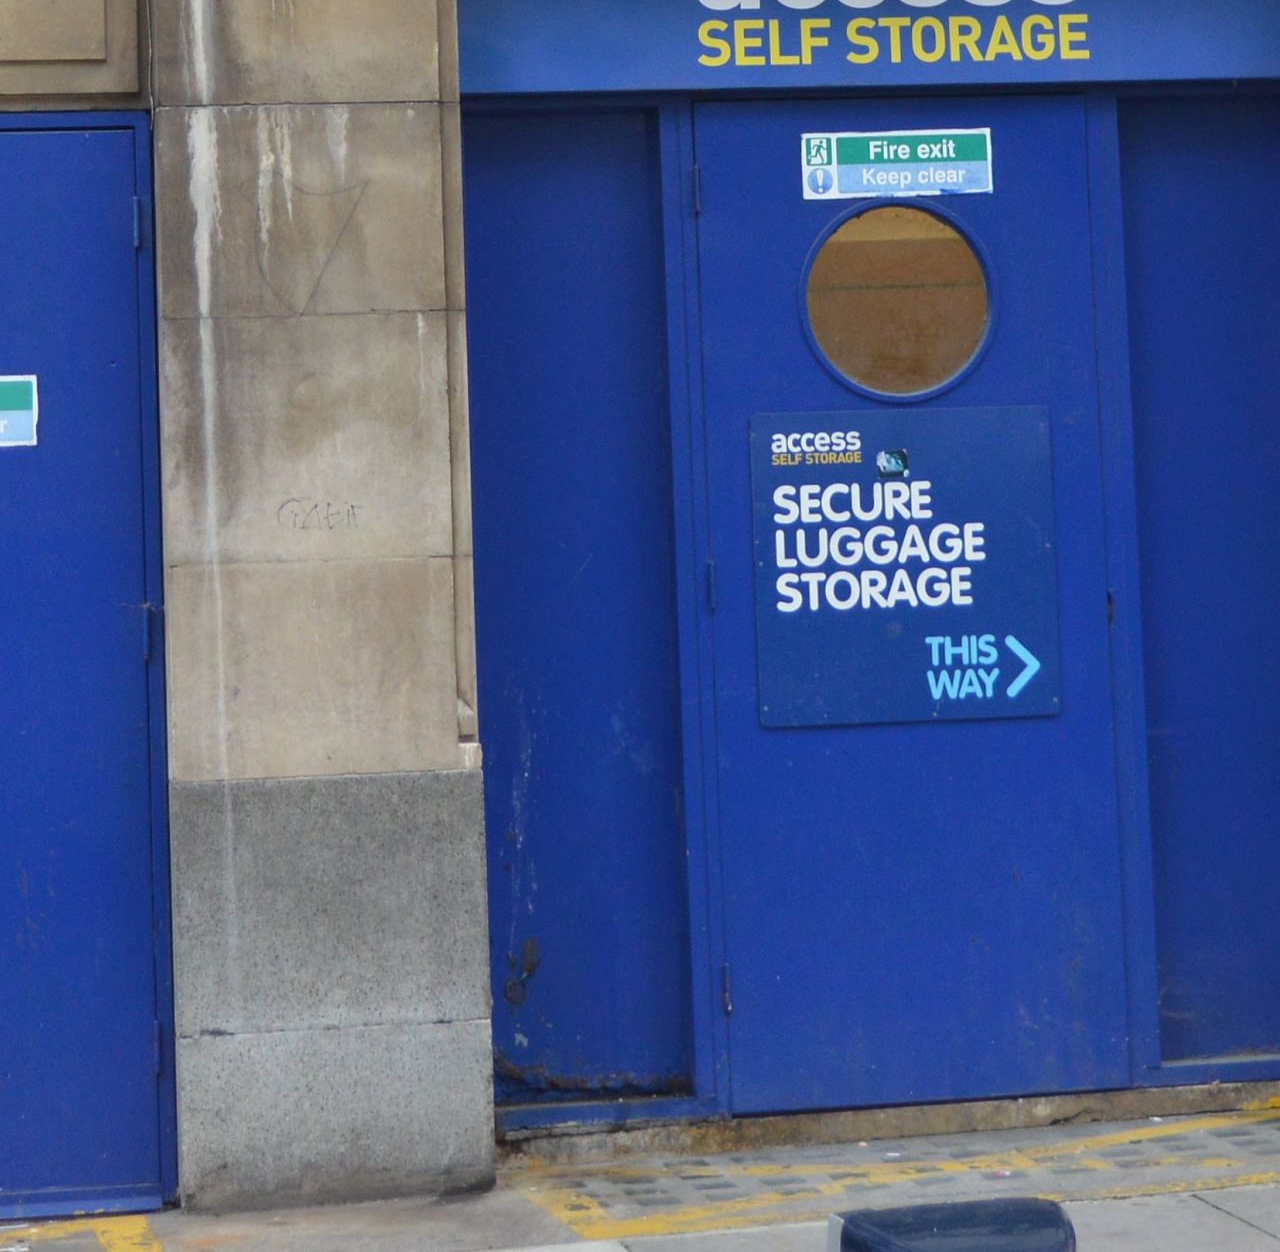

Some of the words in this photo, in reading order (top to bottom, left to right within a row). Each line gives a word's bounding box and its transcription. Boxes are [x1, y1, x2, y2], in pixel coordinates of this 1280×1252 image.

[697, 18, 830, 67] SELF
[846, 13, 1090, 64] STORAGE
[869, 140, 910, 160] Fire
[917, 139, 956, 159] exit
[862, 168, 912, 188] Keep
[918, 167, 966, 184] clear
[771, 431, 861, 453] access
[772, 452, 802, 466] SELF
[806, 451, 862, 465] STORAGE
[773, 480, 933, 524] SECURE
[775, 522, 986, 568] LUGGAGE
[776, 567, 973, 613] STORAGE
[925, 634, 998, 666] THIS
[927, 668, 1000, 700] WAY
